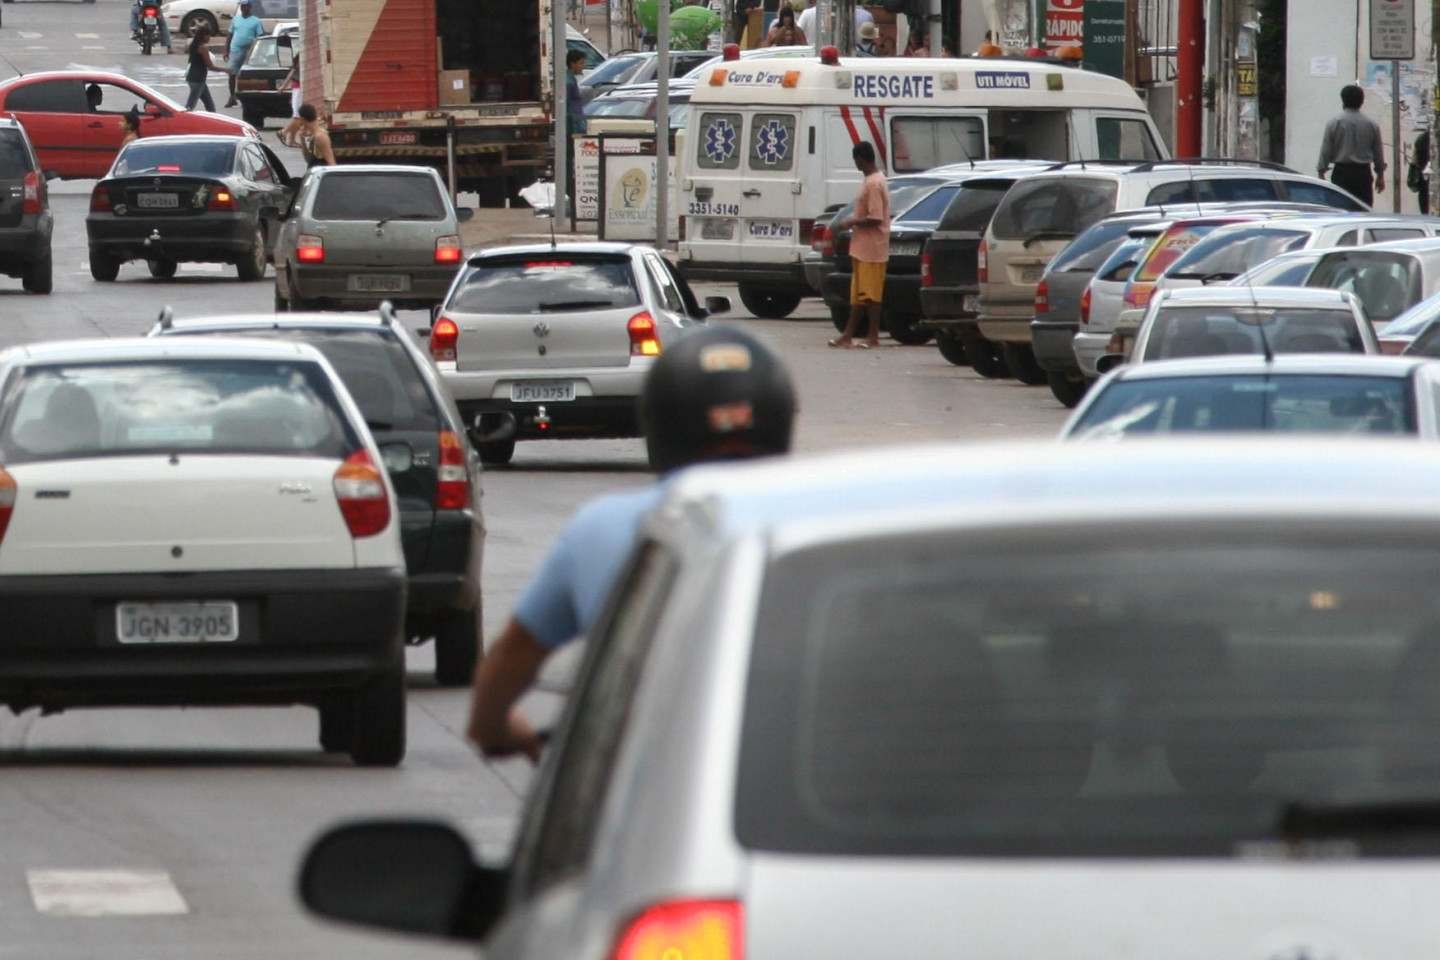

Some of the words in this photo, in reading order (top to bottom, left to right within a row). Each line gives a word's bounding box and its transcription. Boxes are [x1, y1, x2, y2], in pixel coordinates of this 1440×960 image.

[728, 71, 753, 84] Cura
[853, 74, 935, 98] RESGATE
[977, 74, 995, 88] UTI
[996, 72, 1030, 87] MÓVEL
[688, 202, 740, 215] 3351-5140
[749, 222, 769, 236] Cura
[127, 616, 171, 637] JGN
[177, 615, 232, 635] 3905
